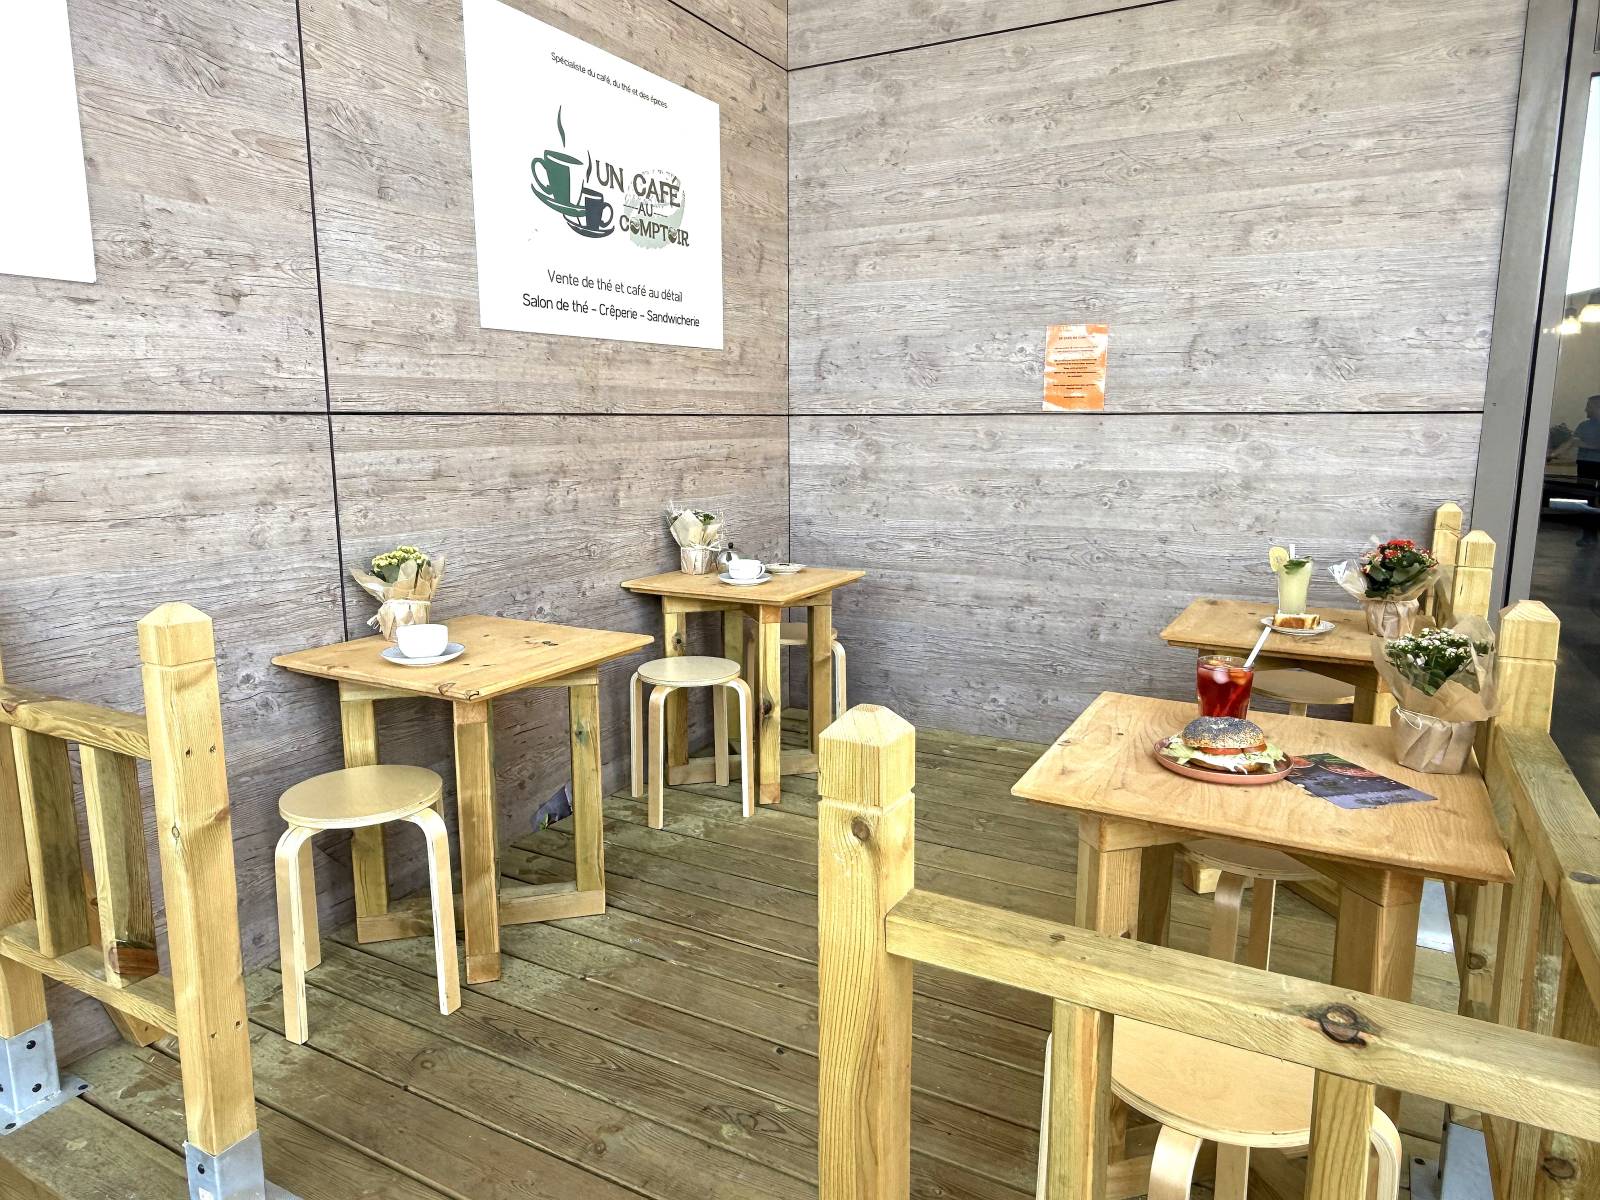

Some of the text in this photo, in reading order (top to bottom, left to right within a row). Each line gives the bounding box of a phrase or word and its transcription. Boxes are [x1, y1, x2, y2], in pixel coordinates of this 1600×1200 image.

[551, 52, 668, 109] Spécialiste du café, du thé et des épices
[596, 160, 681, 208] UN CAFÉ
[638, 204, 653, 217] AU
[619, 215, 690, 247] COMPTOIR
[548, 269, 682, 302] Vente de thé et café au détail
[522, 293, 553, 309] Salon
[556, 298, 569, 311] de
[572, 300, 588, 313] thé
[599, 303, 638, 320] Crêperie
[647, 310, 700, 327] Sandwicherie
